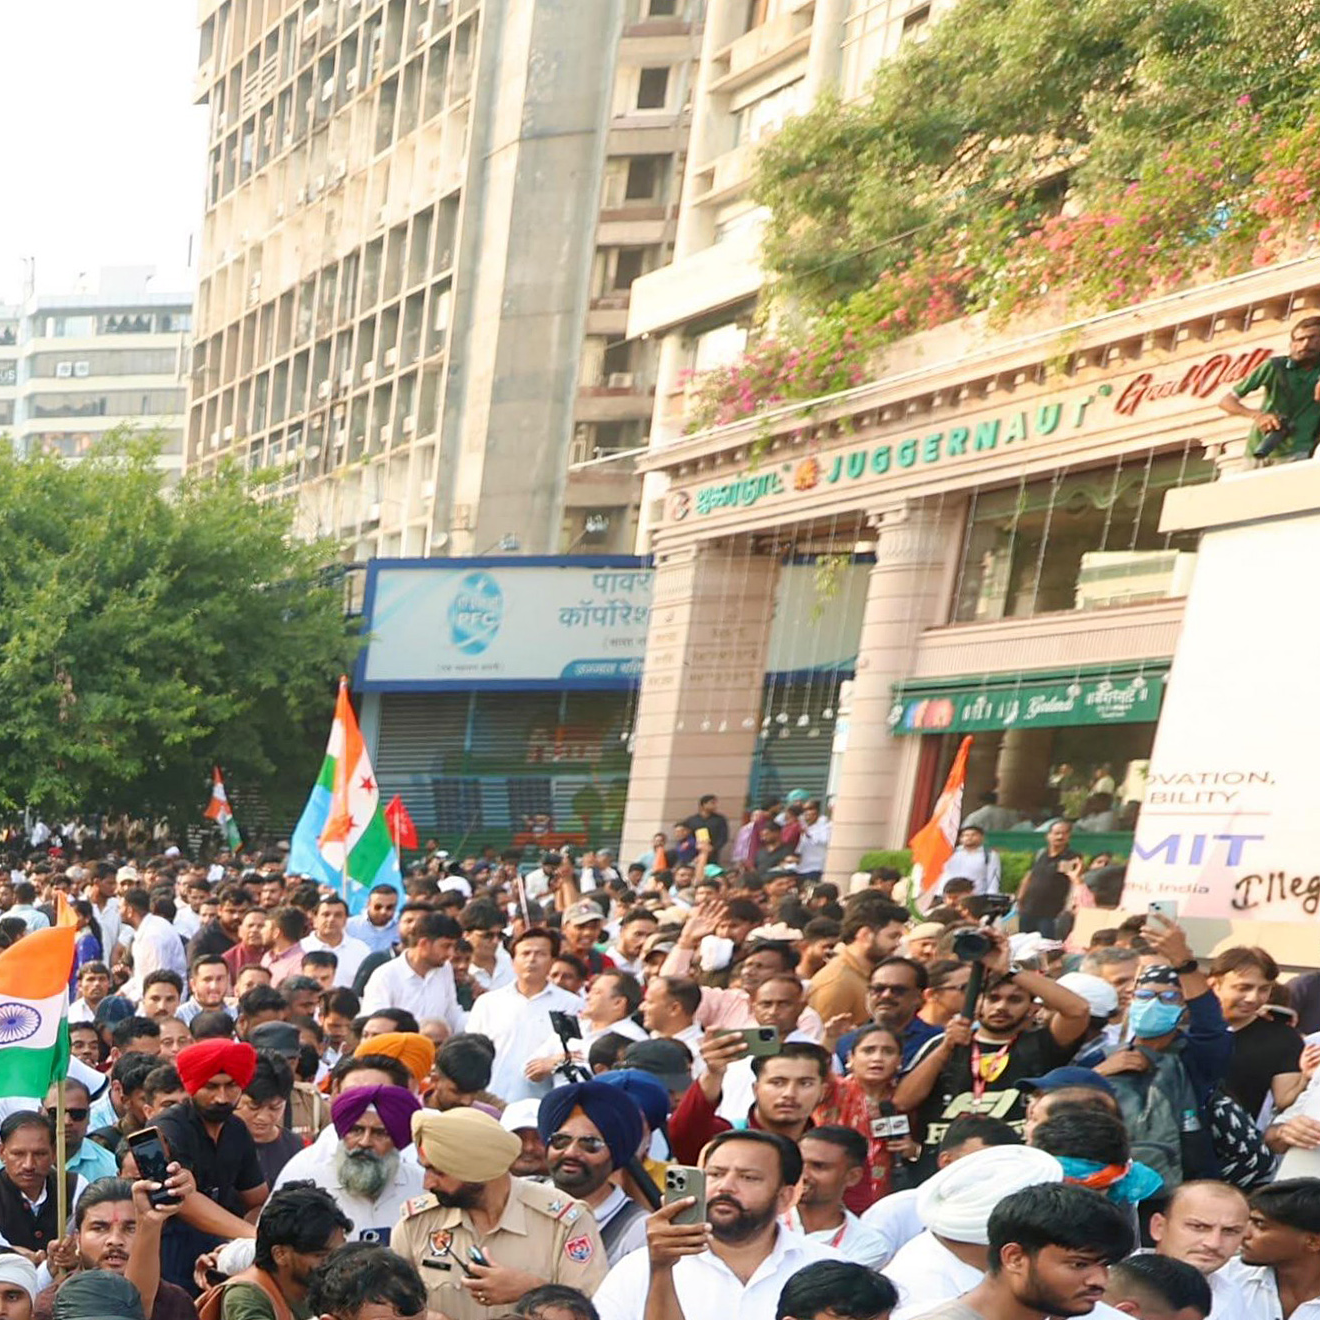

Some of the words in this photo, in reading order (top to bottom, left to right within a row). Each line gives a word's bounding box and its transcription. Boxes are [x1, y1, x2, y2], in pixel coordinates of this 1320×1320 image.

[827, 394, 1095, 483] JUGGERNAUT
[458, 611, 499, 625] PFC
[1158, 882, 1209, 893] India
